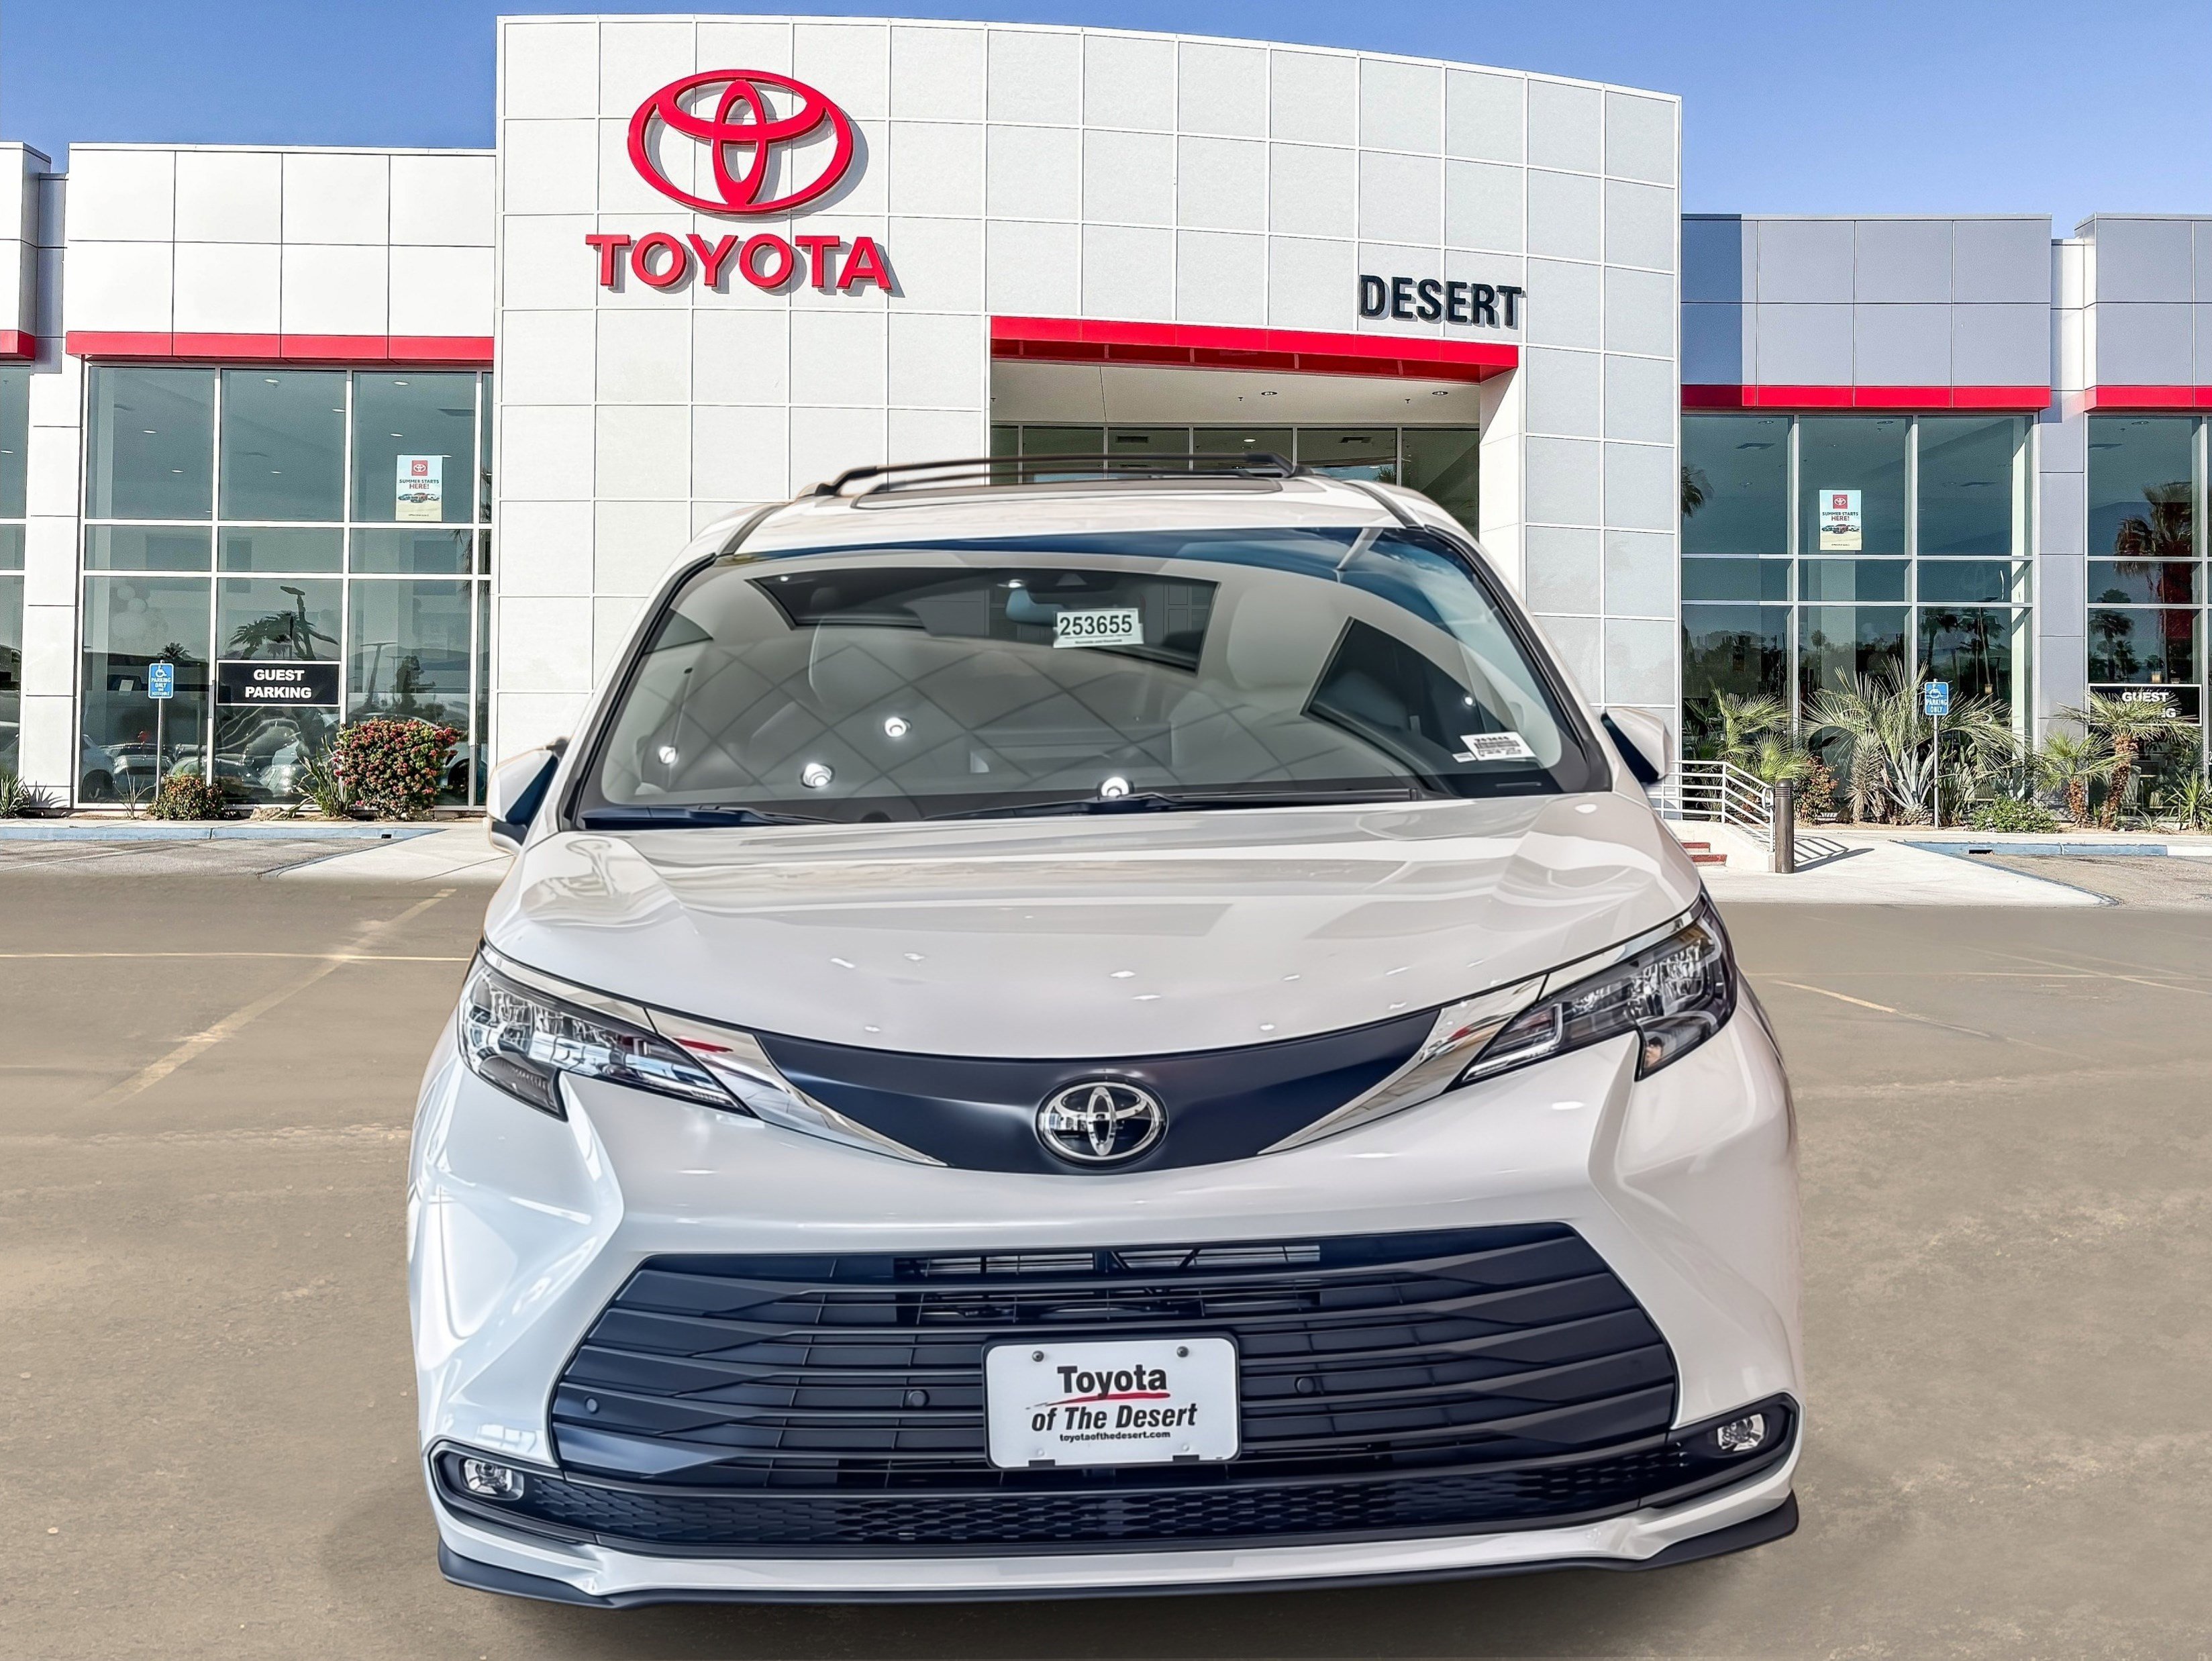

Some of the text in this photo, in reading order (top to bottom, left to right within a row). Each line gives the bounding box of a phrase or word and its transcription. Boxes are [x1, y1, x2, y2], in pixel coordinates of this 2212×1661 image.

[585, 232, 892, 291] TOYOTA
[1359, 274, 1522, 326] DESERT
[1060, 615, 1132, 636] 253655
[254, 669, 305, 681] GUEST
[245, 686, 311, 699] PARKING
[2122, 692, 2169, 702] GUEST
[1057, 1364, 1167, 1400] Toyota
[1032, 1403, 1197, 1431] of The Desert
[1060, 1431, 1171, 1442] toyotaofthedesert.com
